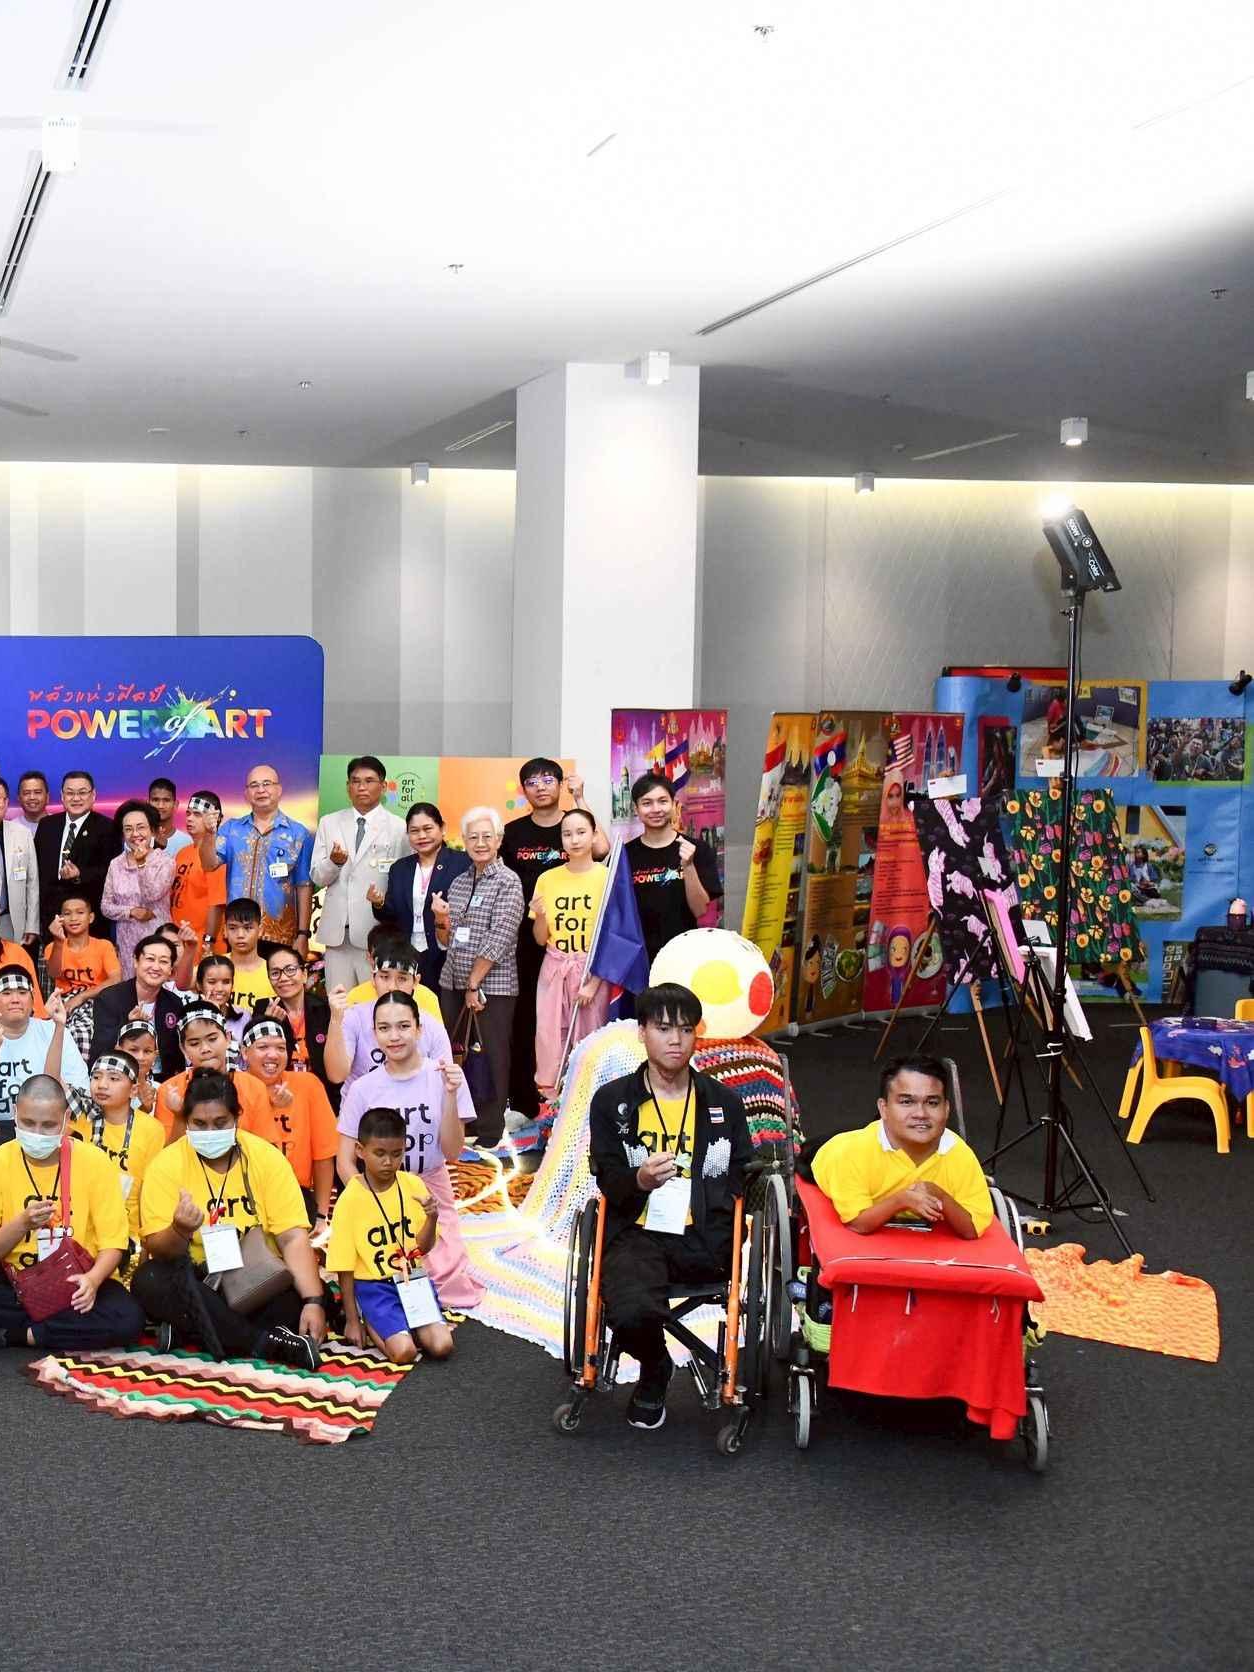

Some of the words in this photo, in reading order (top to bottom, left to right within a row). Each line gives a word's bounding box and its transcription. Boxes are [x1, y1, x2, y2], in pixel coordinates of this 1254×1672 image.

[200, 709, 272, 739] ART
[401, 785, 415, 794] for
[401, 793, 414, 802] all
[554, 894, 592, 910] art
[554, 913, 587, 931] for
[555, 935, 589, 953] all
[63, 966, 95, 982] art
[398, 1103, 432, 1125] rt
[638, 1131, 692, 1157] art
[367, 1216, 415, 1247] art
